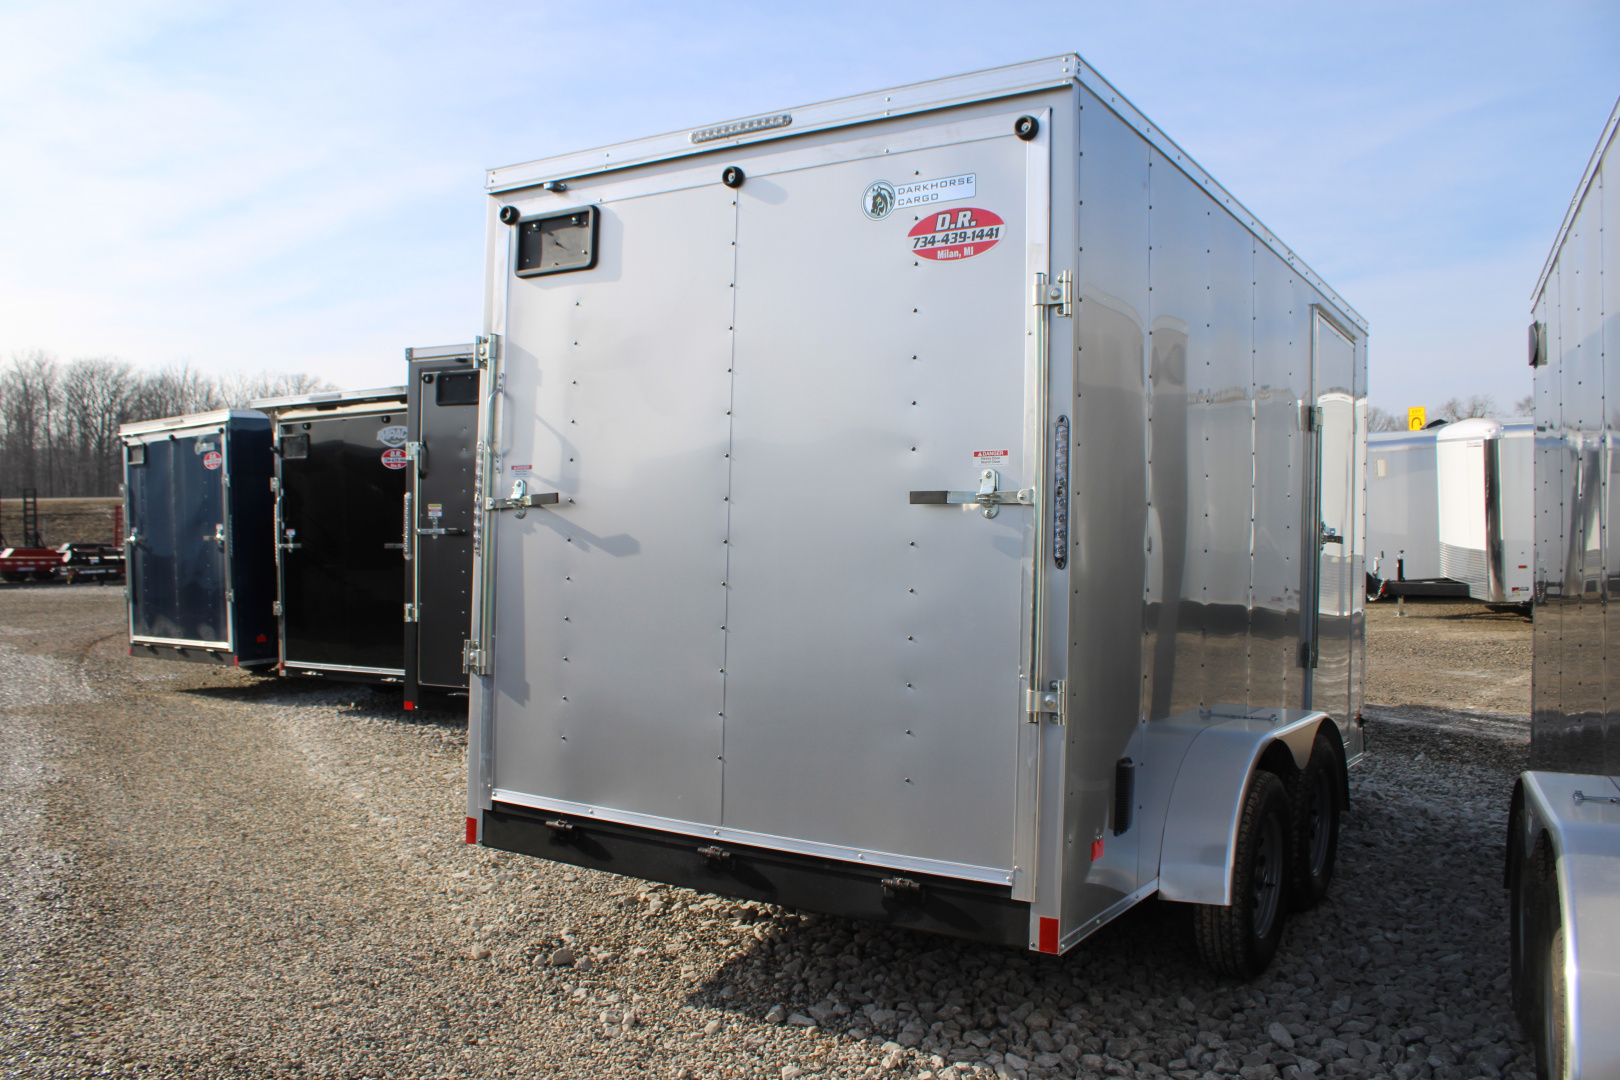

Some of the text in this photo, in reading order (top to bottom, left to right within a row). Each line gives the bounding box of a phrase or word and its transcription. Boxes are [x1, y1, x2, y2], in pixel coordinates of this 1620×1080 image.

[898, 176, 974, 194] DARKHORSE
[898, 193, 939, 206] CARGO
[935, 209, 977, 232] D.R.
[913, 227, 1000, 249] 734-439-1441
[937, 246, 974, 260] Milan, MI
[376, 429, 408, 441] IMPAC
